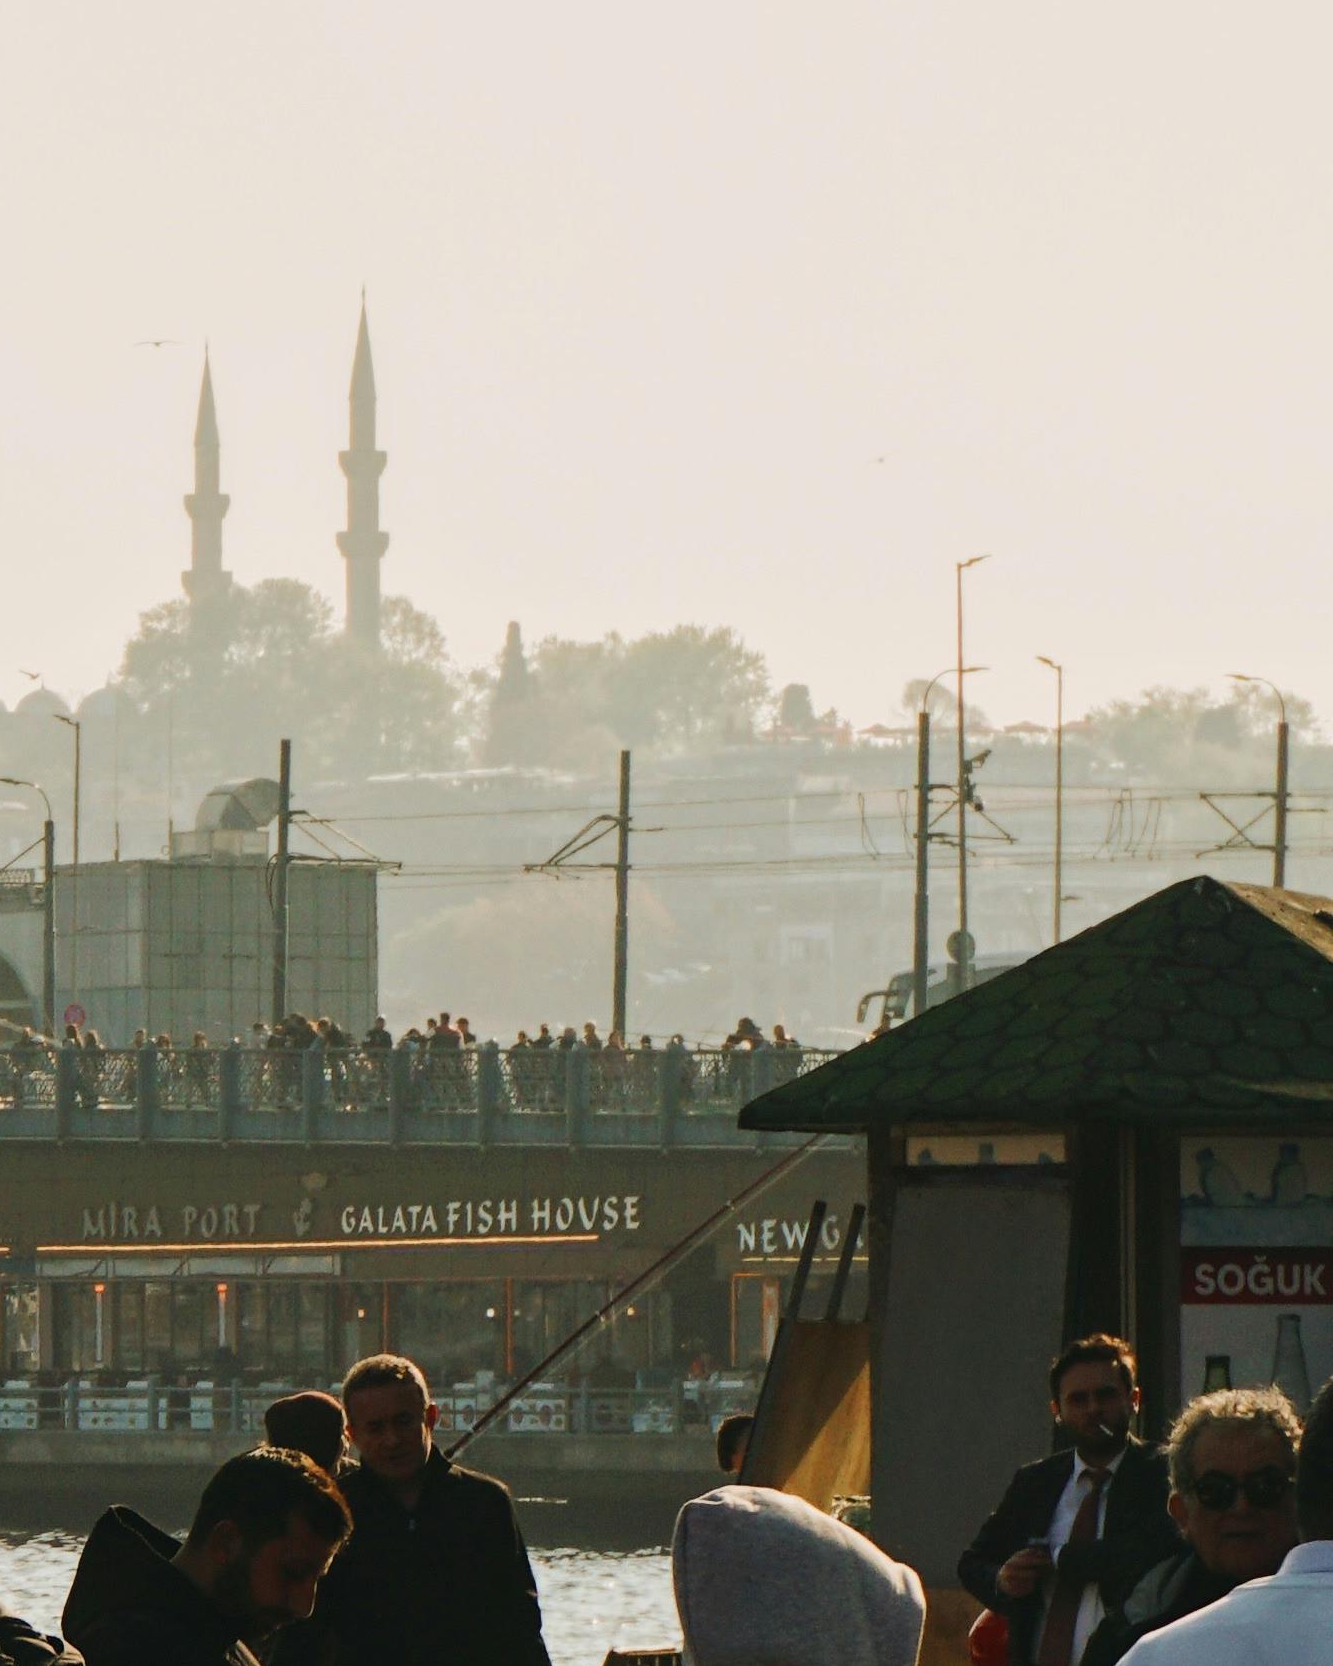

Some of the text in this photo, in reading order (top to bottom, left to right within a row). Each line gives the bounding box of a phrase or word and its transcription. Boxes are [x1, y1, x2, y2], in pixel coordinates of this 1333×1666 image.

[181, 1202, 262, 1239] PORT
[340, 1196, 641, 1235] GALATA FISH HOUSE
[736, 1218, 811, 1253] NEW
[1194, 1254, 1327, 1296] SOĞUK
